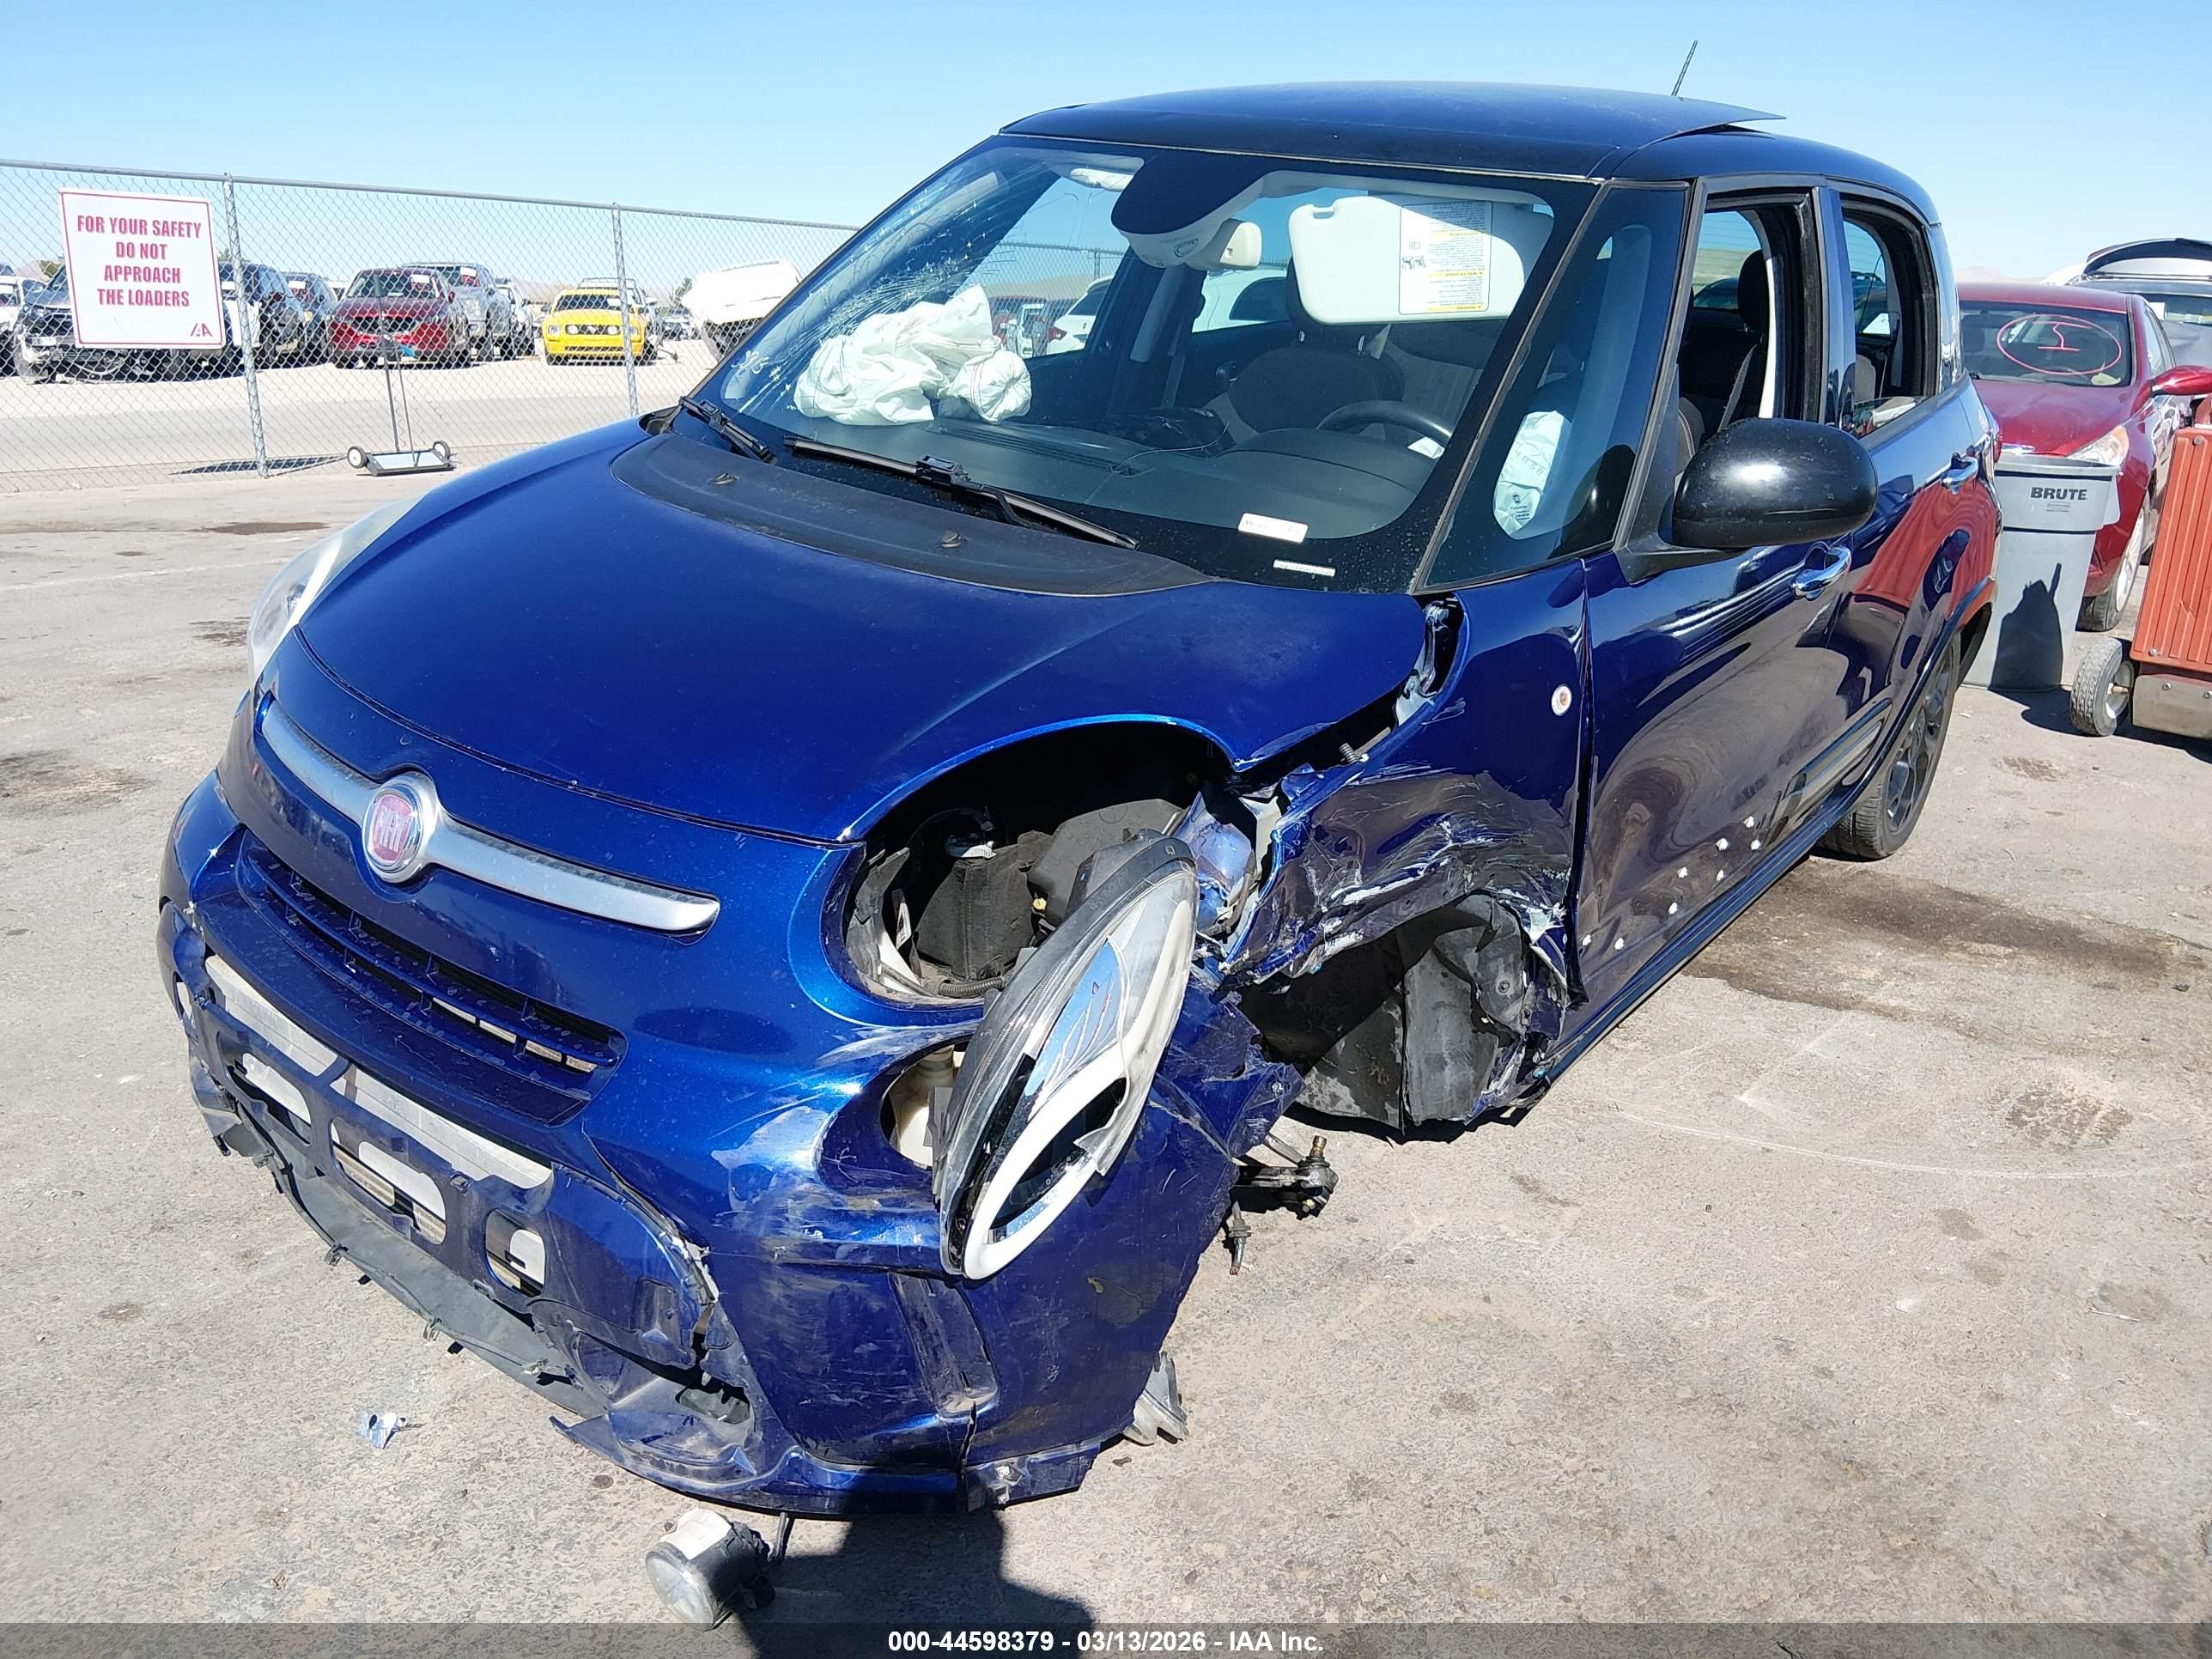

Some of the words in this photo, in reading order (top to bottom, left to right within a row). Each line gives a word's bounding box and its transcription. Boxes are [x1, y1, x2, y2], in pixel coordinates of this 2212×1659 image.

[77, 215, 105, 234] FOR
[109, 217, 149, 236] YOUR
[152, 220, 202, 239] SAFETY
[116, 241, 135, 258] DO
[140, 243, 168, 259] NOT
[104, 264, 181, 283] APPROACH
[97, 289, 125, 306] THE
[128, 289, 190, 307] LOADERS
[2030, 486, 2088, 501] BRUTE
